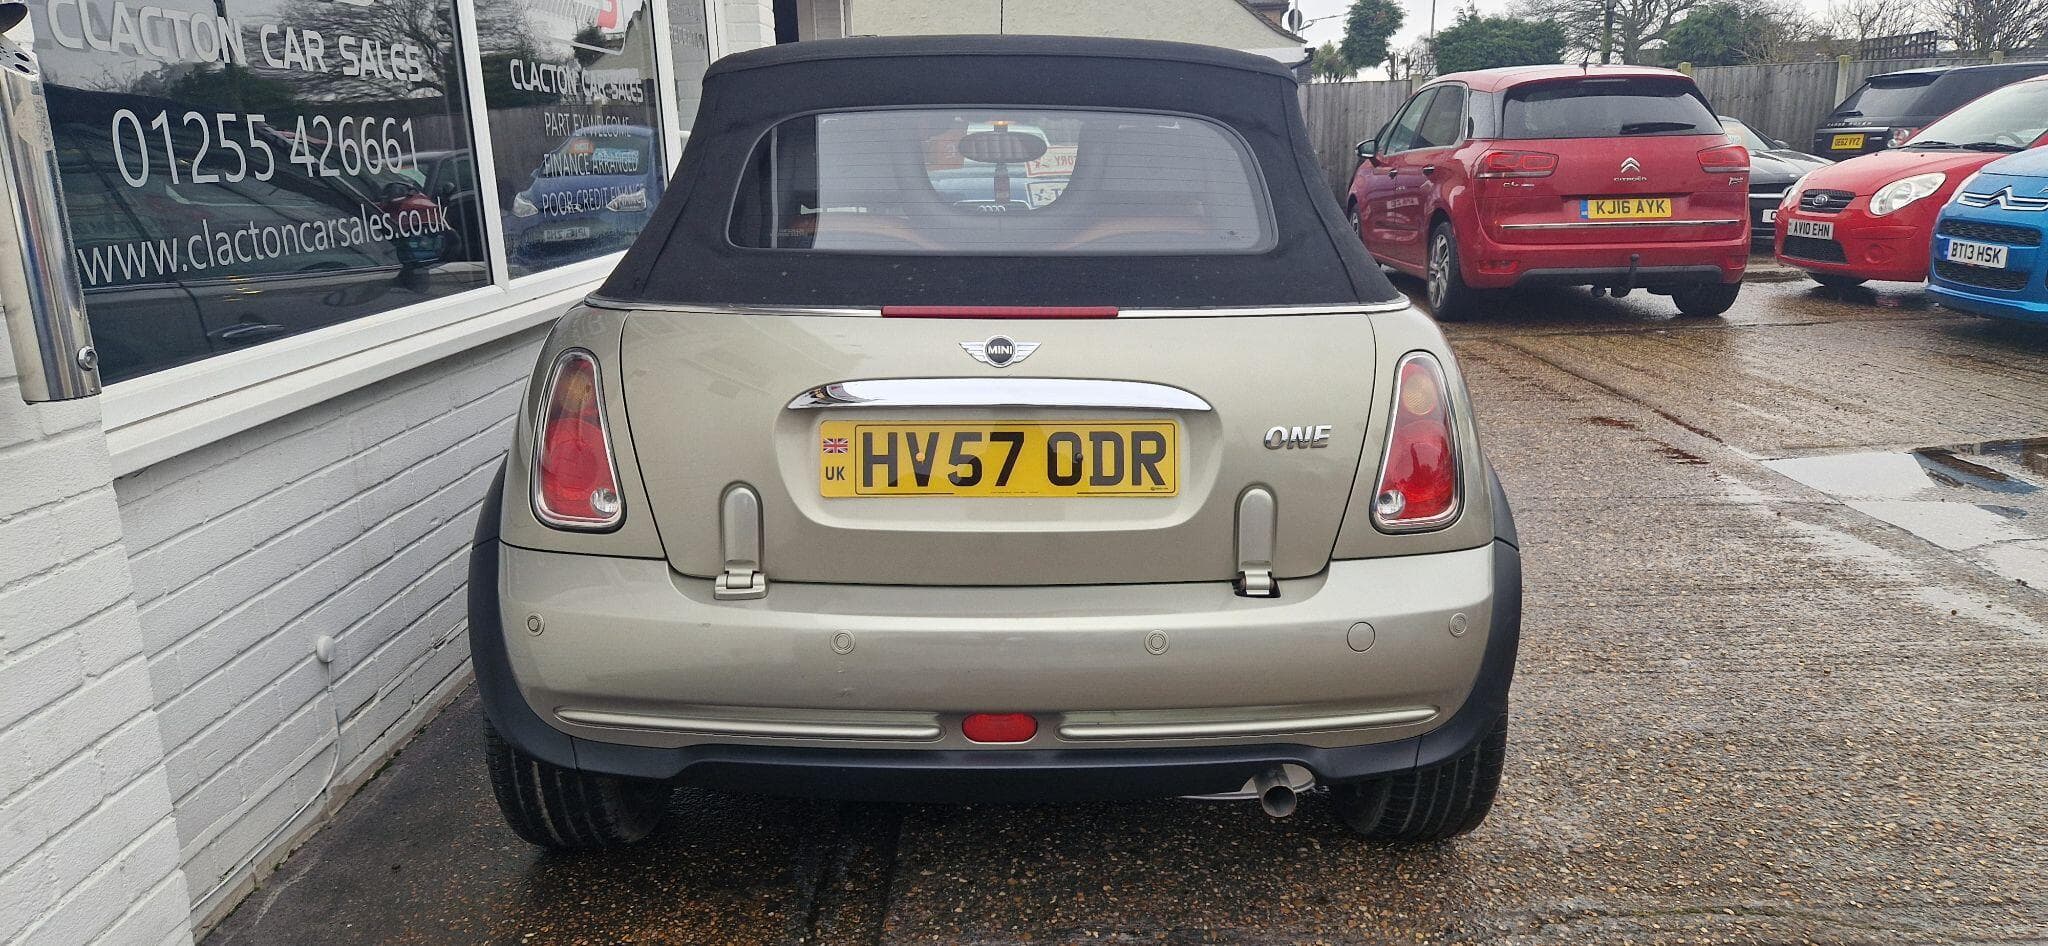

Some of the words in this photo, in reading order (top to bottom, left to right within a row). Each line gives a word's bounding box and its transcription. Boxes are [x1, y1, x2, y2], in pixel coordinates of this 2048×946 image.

[47, 0, 246, 66] CLACTON
[260, 23, 329, 72] CAR
[338, 35, 423, 82] SALES
[509, 58, 578, 96] CLACTON
[581, 67, 608, 100] CAR
[610, 74, 644, 103] SALES
[544, 111, 570, 137] PART
[573, 113, 586, 137] EX
[586, 114, 631, 138] WELCOME
[112, 108, 274, 188] 01255
[290, 114, 419, 178] 426661
[544, 152, 590, 178] FINANCE
[592, 150, 639, 175] ARRANGED
[541, 189, 574, 218] POOR
[574, 186, 608, 213] CREDIT
[610, 183, 646, 207] FINANCE
[1596, 201, 1631, 215] KJ16
[1636, 200, 1666, 214] AYK
[78, 196, 452, 286] www.clactoncarsales.co.uk
[1794, 221, 1811, 235] AV10
[1812, 223, 1830, 237] EHN
[1951, 241, 1975, 260] BT13
[1976, 245, 2001, 264] HSK
[988, 345, 1013, 355] MINI
[1263, 424, 1332, 451] ONE
[862, 430, 1026, 488] HV57
[1046, 430, 1167, 487] ODR
[825, 465, 846, 481] UK
